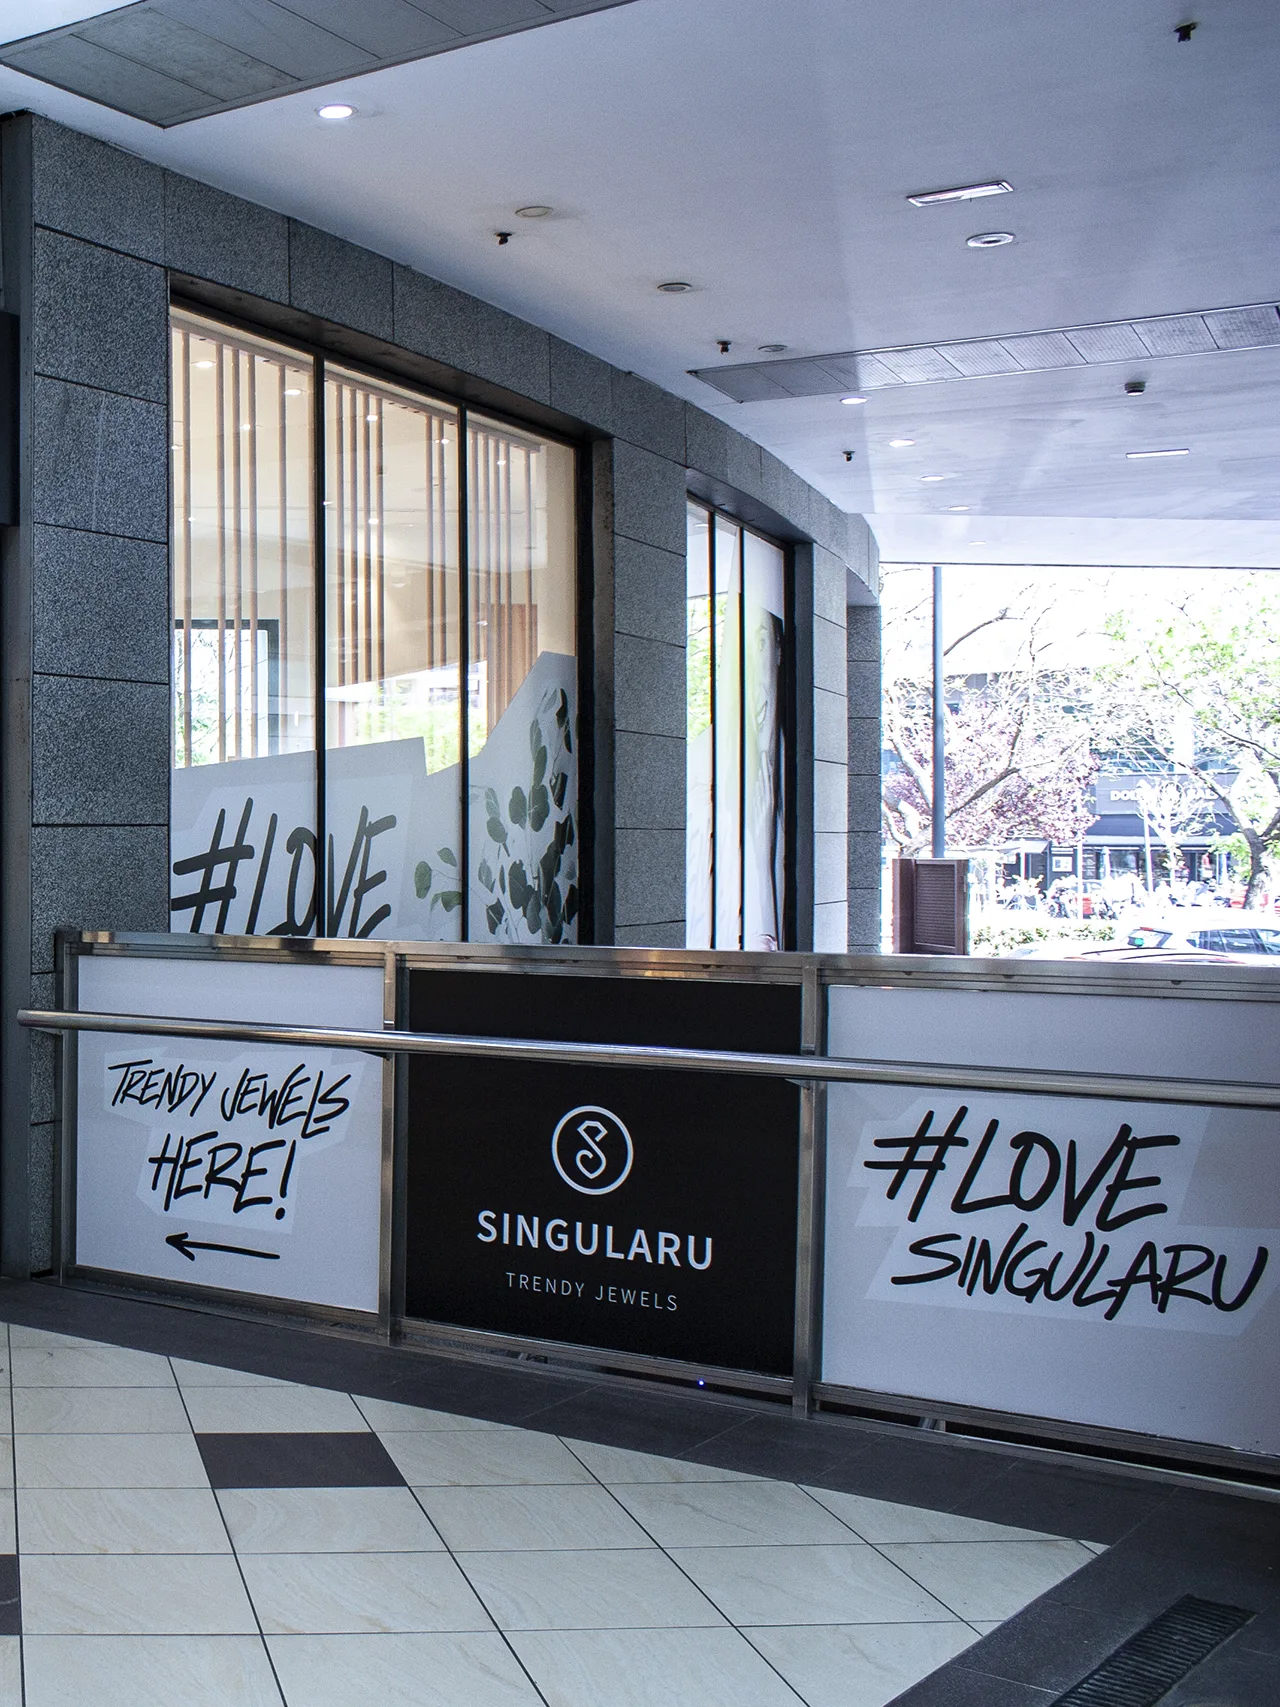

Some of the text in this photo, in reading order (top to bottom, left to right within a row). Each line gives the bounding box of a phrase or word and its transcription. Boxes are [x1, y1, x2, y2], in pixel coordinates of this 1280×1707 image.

[171, 797, 397, 938] #LOVE
[107, 1058, 352, 1139] TRENDY JEWELS
[147, 1131, 298, 1220] HERE!
[863, 1105, 1181, 1232] #LOVE
[476, 1210, 713, 1270] SINGULARU
[891, 1223, 1269, 1321] SINGULARU
[506, 1271, 678, 1312] TRENDY JEWELS
